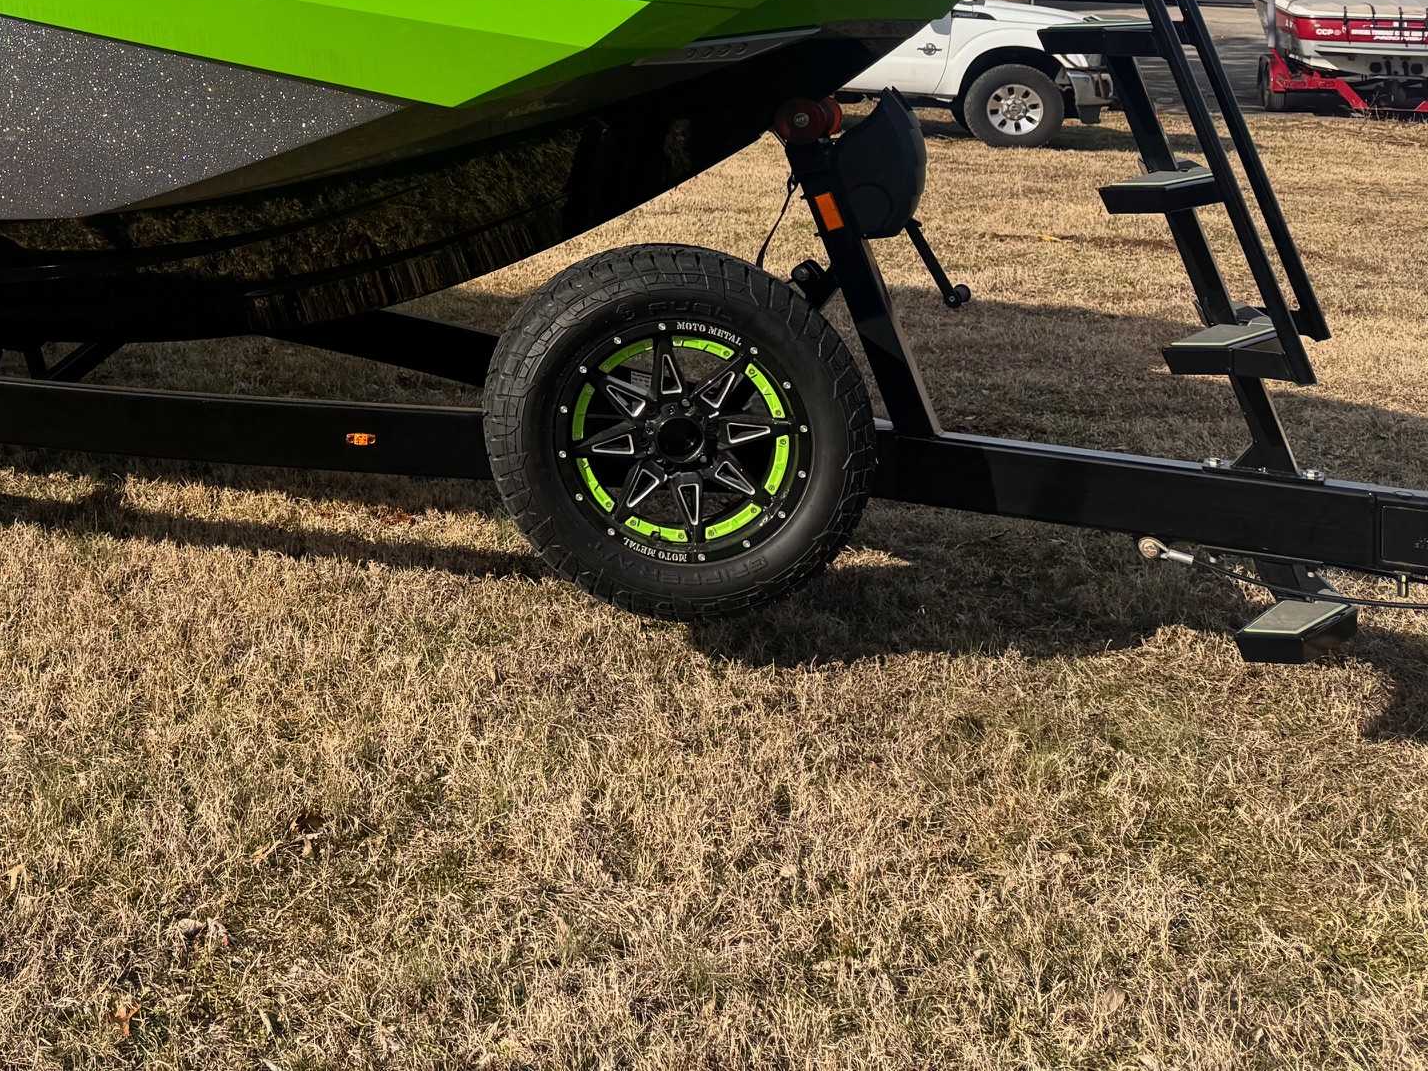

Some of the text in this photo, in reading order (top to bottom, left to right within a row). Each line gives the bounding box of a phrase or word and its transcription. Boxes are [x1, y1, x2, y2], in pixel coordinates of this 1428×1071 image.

[676, 321, 742, 346] MOTO METAL
[623, 536, 656, 558] METAL
[658, 551, 688, 563] MOTO
